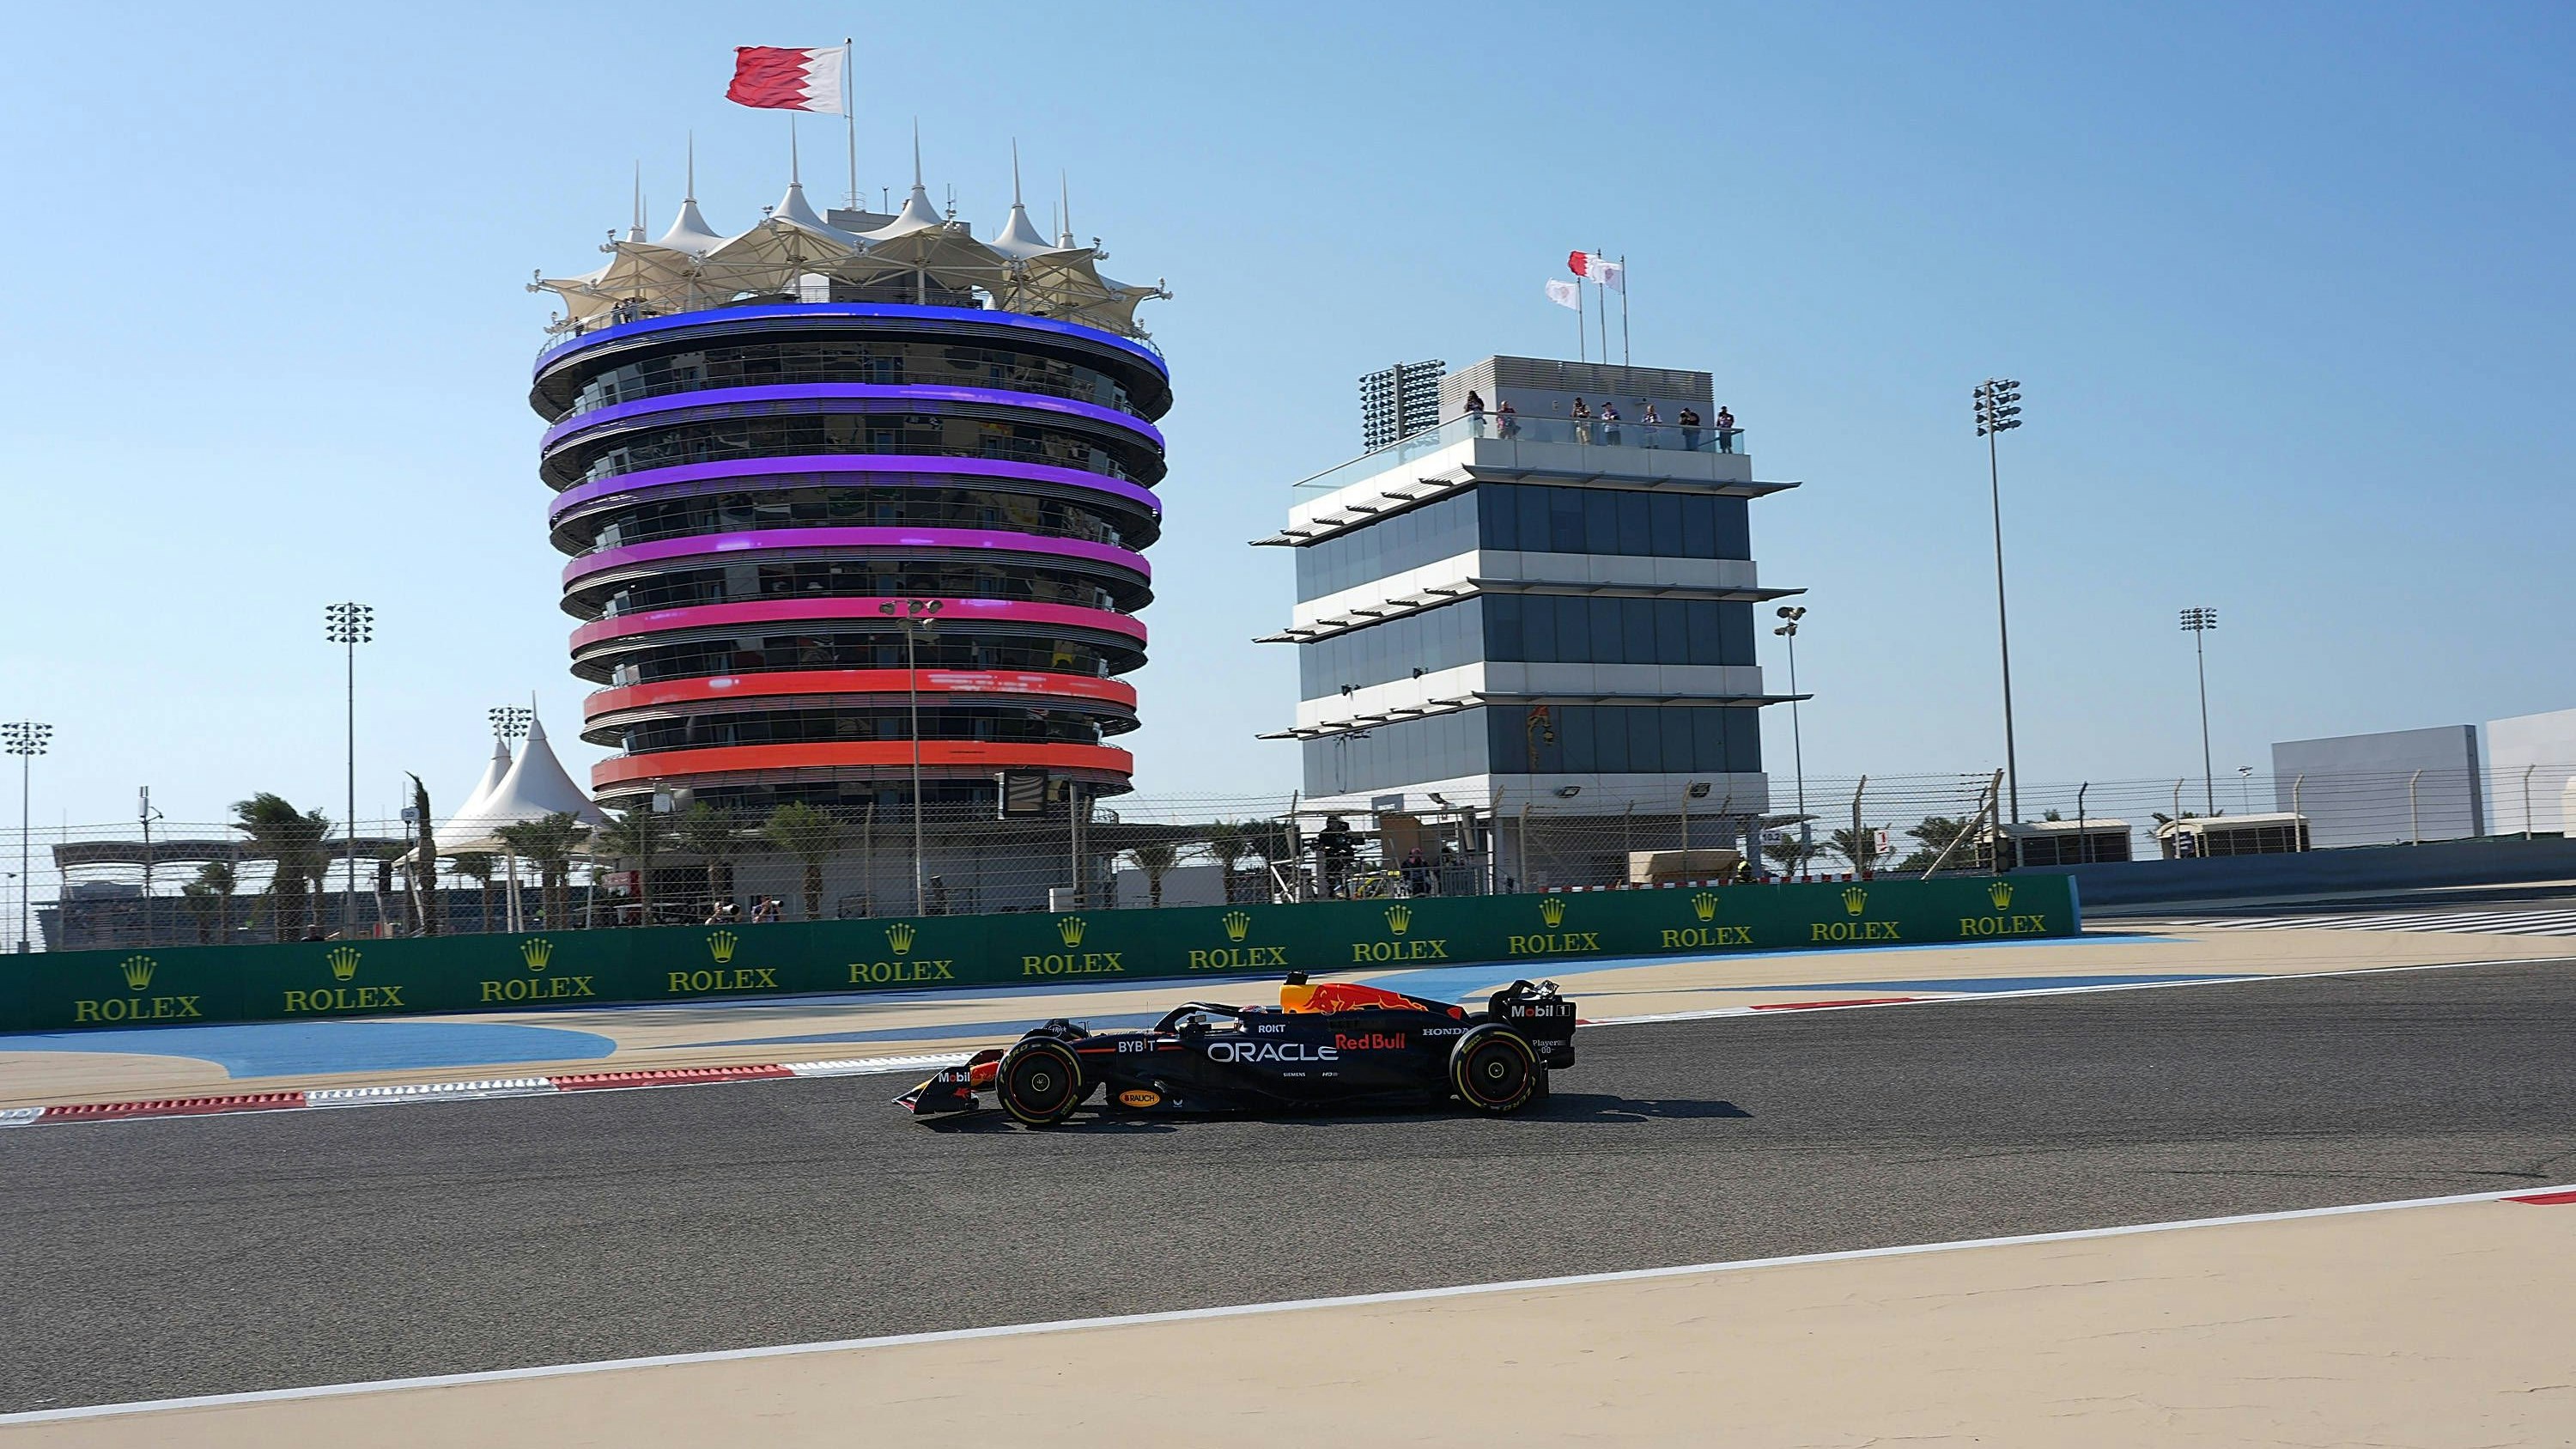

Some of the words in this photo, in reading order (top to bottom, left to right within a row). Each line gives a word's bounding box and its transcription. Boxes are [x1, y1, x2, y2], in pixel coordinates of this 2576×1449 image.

[1810, 921, 1902, 941] ROLEX
[1959, 914, 2048, 936] ROLEX
[1507, 932, 1601, 954] ROLEX
[1661, 926, 1754, 948] ROLEX
[1188, 947, 1289, 970] ROLEX
[1352, 939, 1449, 962] ROLEX
[848, 959, 956, 983] ROLEX
[1021, 953, 1125, 976] ROLEX
[480, 976, 596, 1002] ROLEX
[667, 968, 779, 992] ROLEX
[75, 995, 202, 1022] ROLEX
[283, 985, 405, 1012] ROLEX
[1511, 1005, 1553, 1018] Mobil
[1258, 1024, 1286, 1033] ROKT
[1422, 1027, 1469, 1036] HONDA
[1118, 1038, 1156, 1053] BYBIT
[1335, 1033, 1370, 1050] Red
[1373, 1032, 1406, 1050] Bull
[1207, 1043, 1340, 1062] ORACLE
[939, 1072, 970, 1083] Mobil
